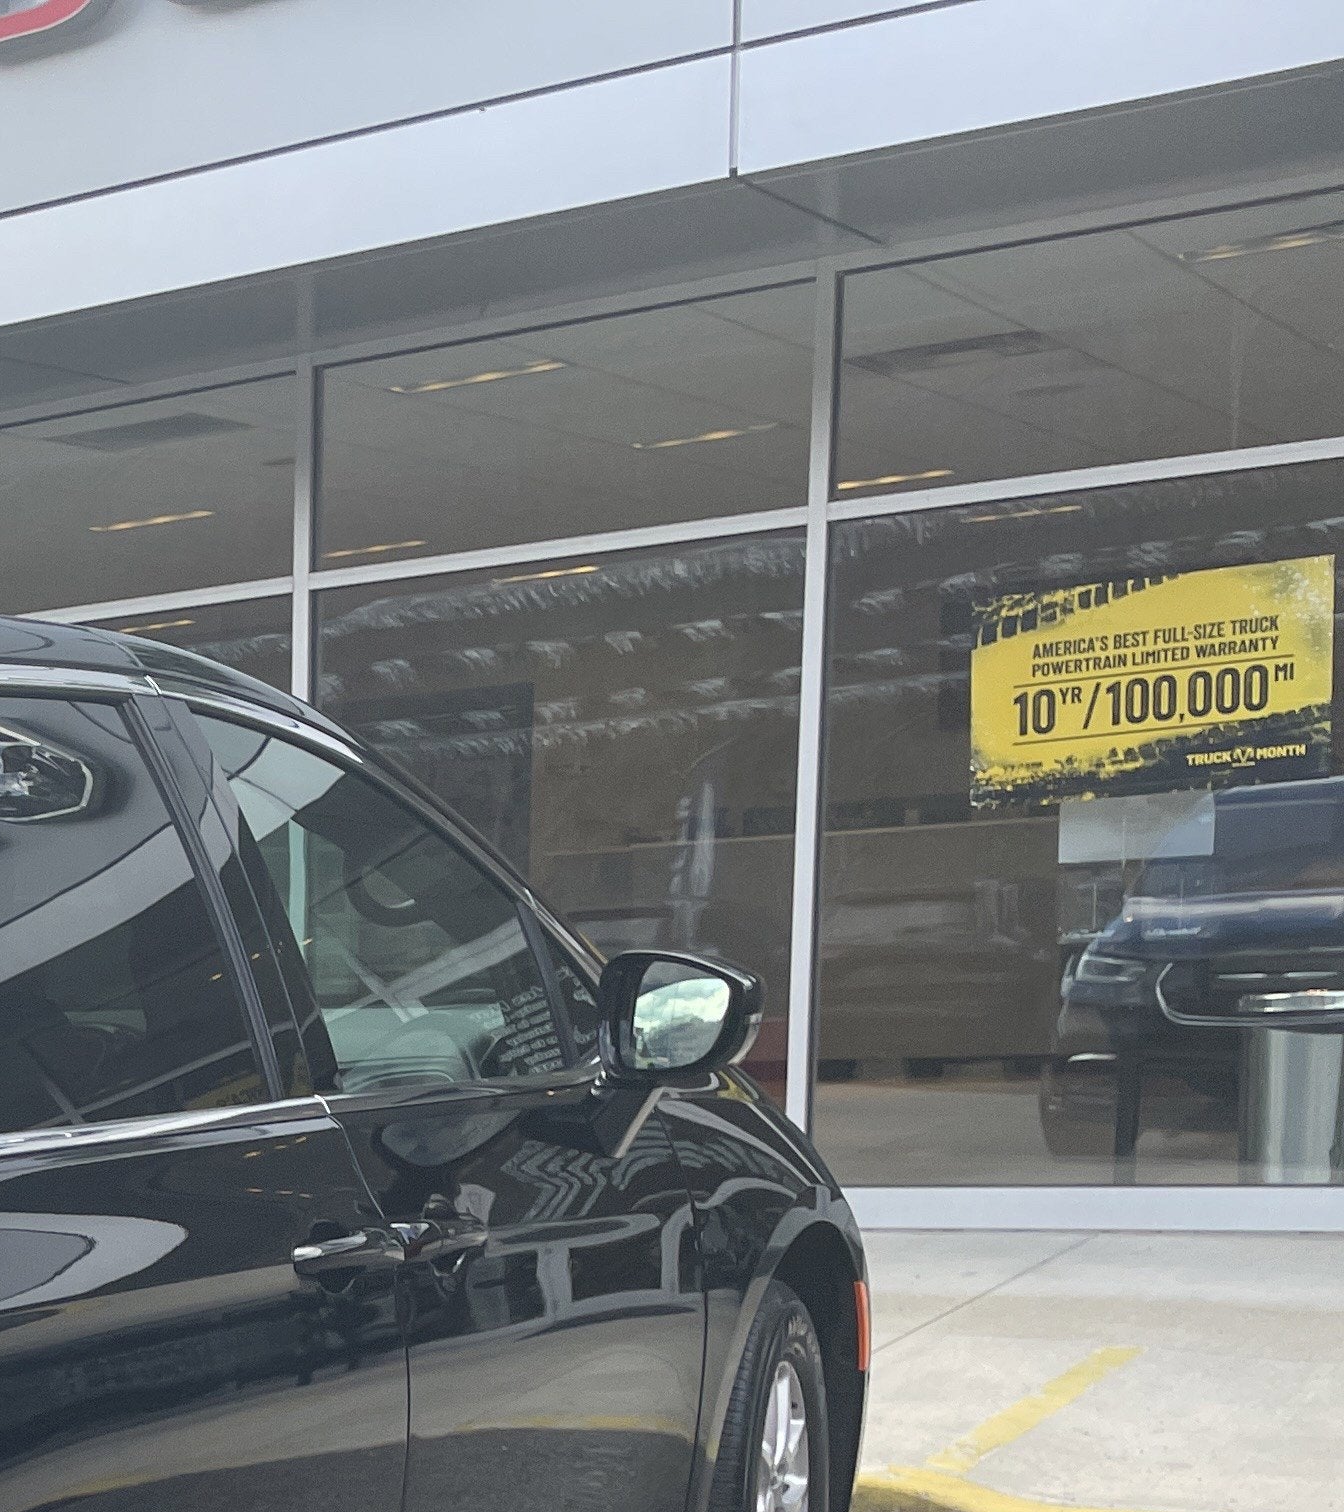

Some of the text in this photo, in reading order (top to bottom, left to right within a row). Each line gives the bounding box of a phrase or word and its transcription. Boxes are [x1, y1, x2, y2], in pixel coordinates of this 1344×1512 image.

[1032, 615, 1280, 660] AMERICA'S BEST FULL-SIZE TRUCK
[1032, 635, 1279, 678] POWERTRAIN LIMITED WARRANTY
[1186, 743, 1306, 766] TRUCK MONTH
